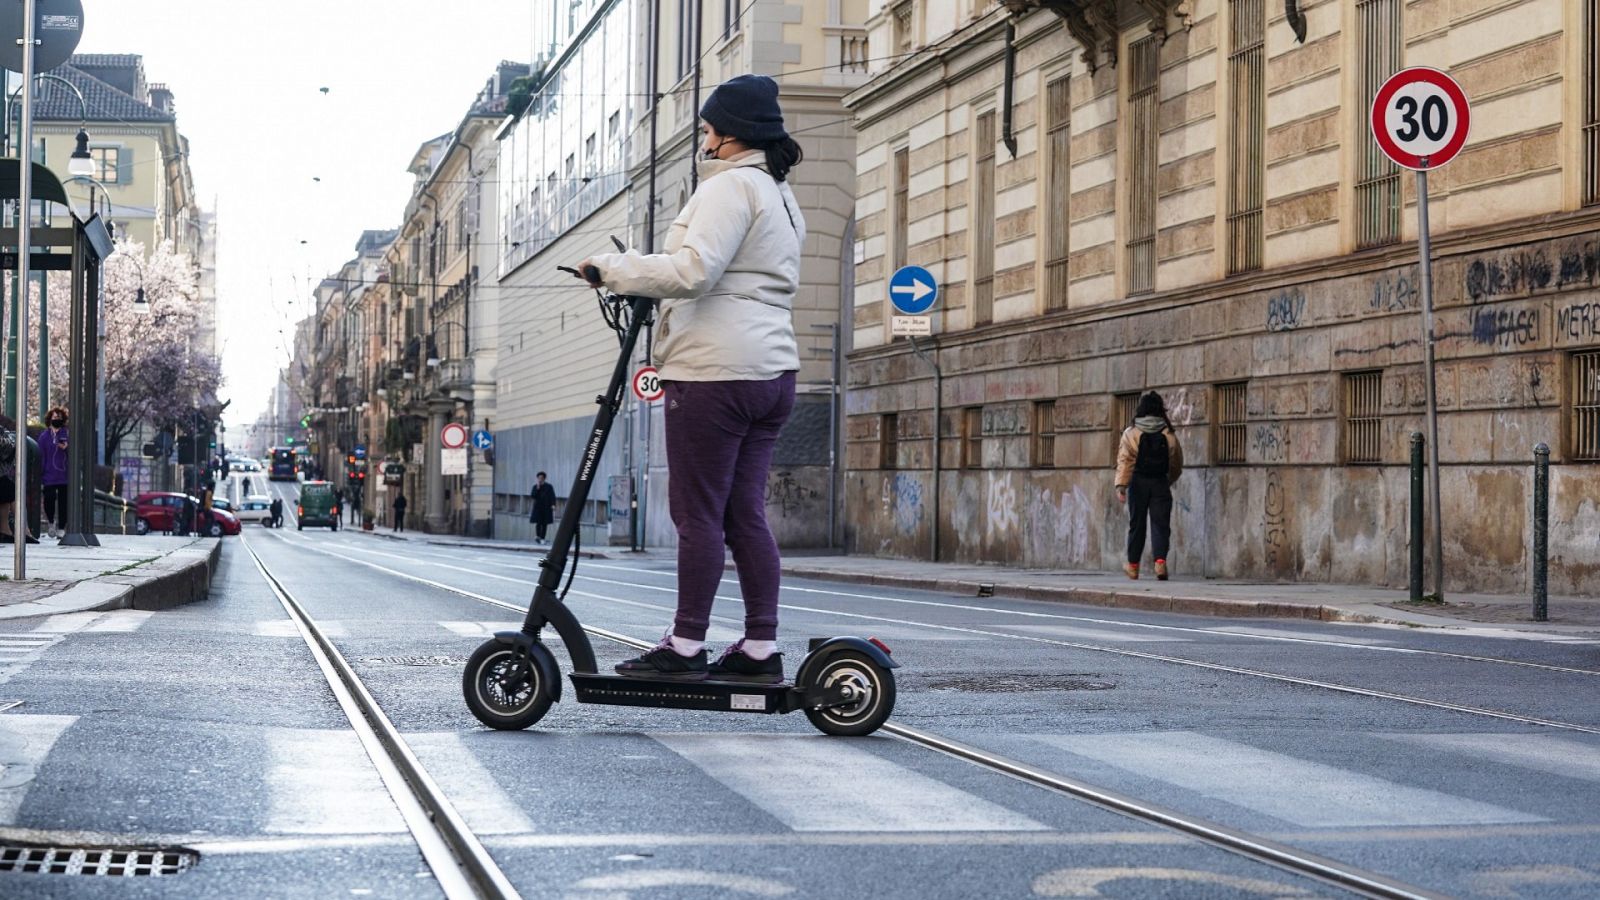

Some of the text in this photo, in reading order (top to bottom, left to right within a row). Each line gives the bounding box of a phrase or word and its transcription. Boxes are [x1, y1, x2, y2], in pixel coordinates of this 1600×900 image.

[1395, 94, 1449, 142] 30
[640, 376, 660, 393] 30
[580, 429, 603, 480] www.zbike.it
